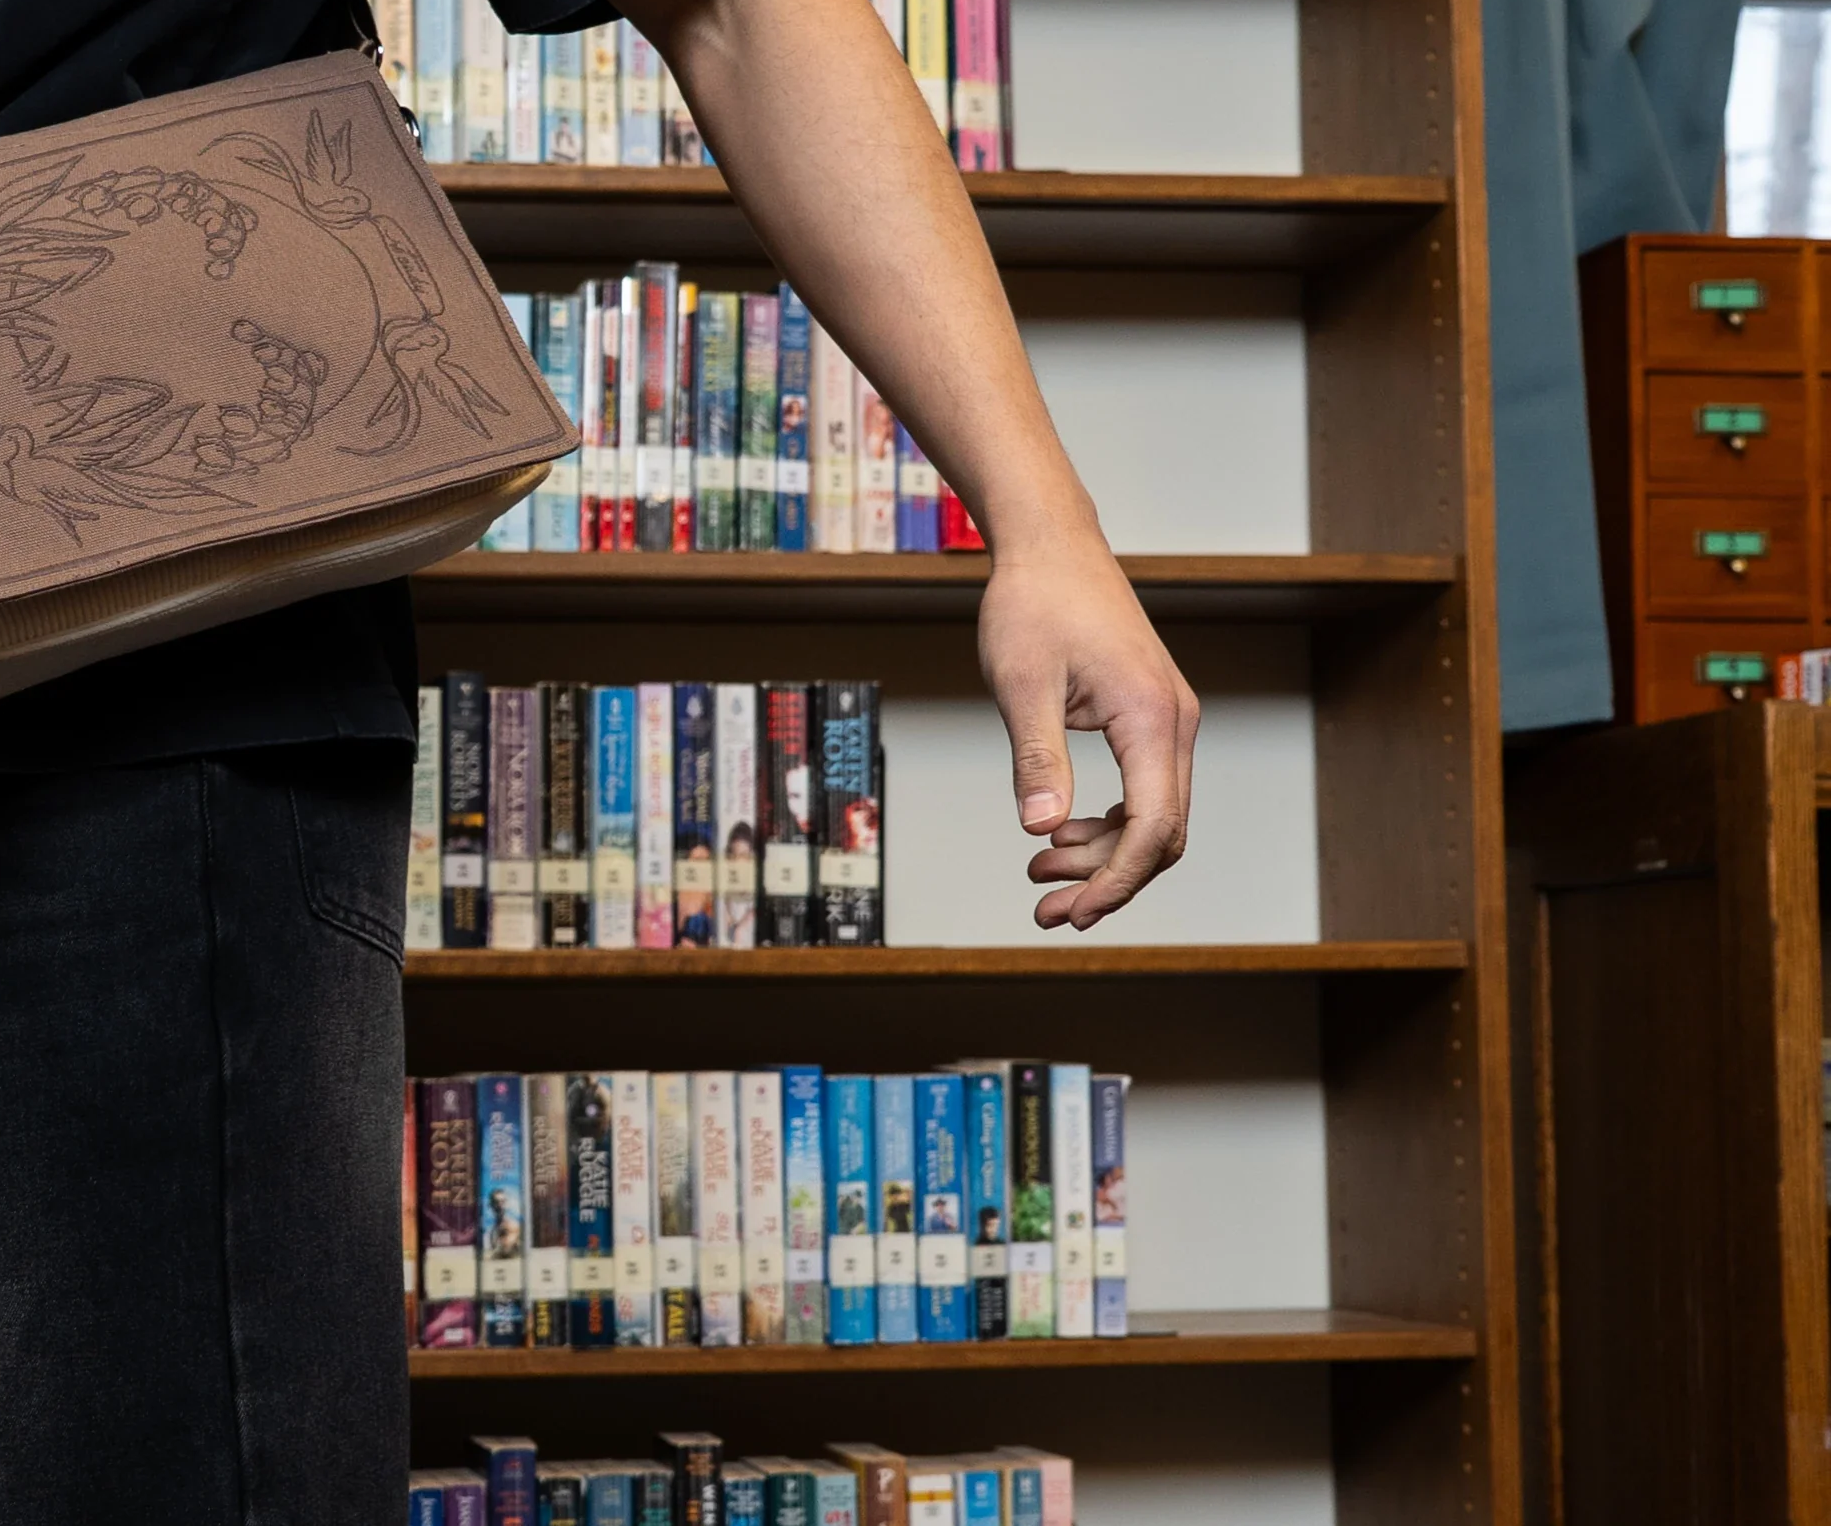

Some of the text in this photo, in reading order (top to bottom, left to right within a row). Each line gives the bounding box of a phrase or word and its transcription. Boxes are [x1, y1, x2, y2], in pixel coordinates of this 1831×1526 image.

[824, 720, 842, 792] ROSE
[430, 1120, 450, 1206] ROSE
[452, 1119, 468, 1206] KAREN
[547, 1129, 558, 1183] KATIE
[579, 1138, 595, 1223] RUGGLE
[595, 1151, 608, 1207] KATIE
[632, 1127, 643, 1181] KATIE
[716, 1127, 727, 1179] KATIE
[763, 1130, 774, 1183] KATIE
